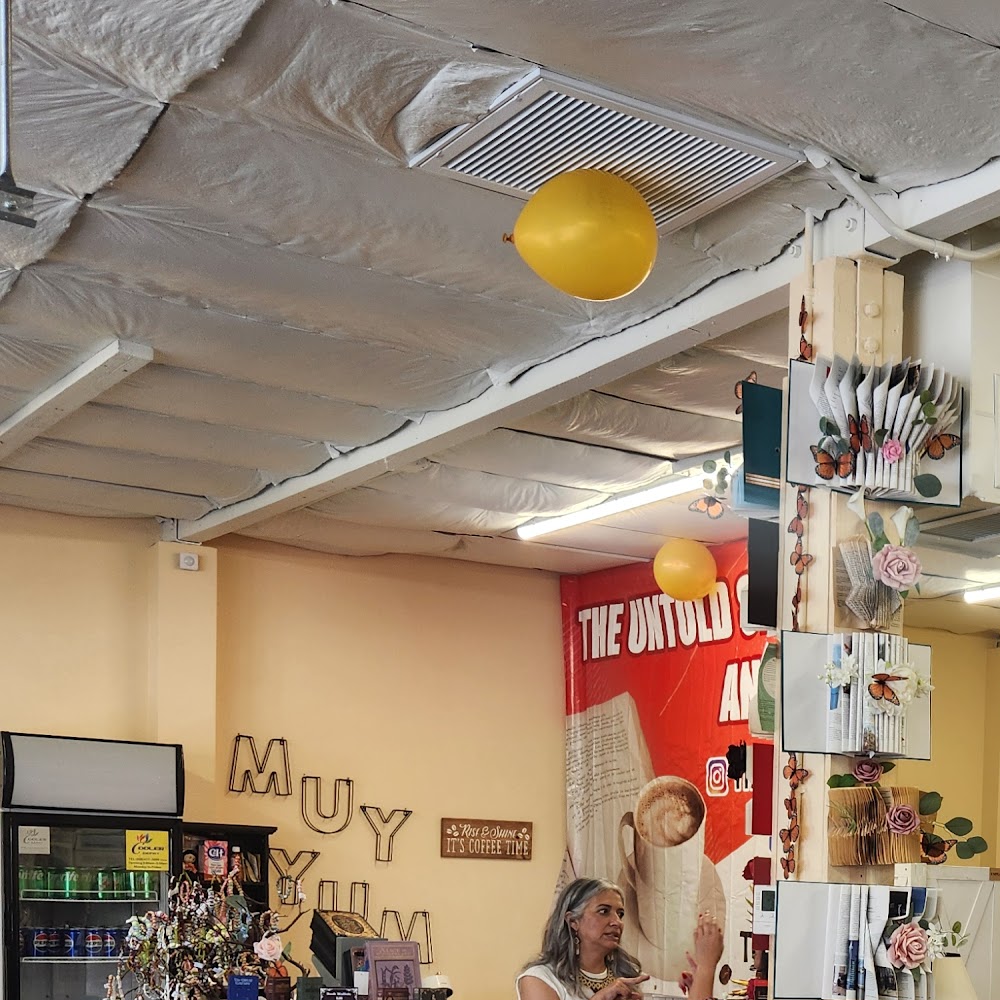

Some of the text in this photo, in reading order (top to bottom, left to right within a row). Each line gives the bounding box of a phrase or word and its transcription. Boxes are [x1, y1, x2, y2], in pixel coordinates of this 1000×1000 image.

[578, 603, 625, 661] THE
[628, 581, 733, 654] UNTOLD
[229, 733, 413, 862] MUY
[446, 837, 529, 856] IT'S COFFEE TIME
